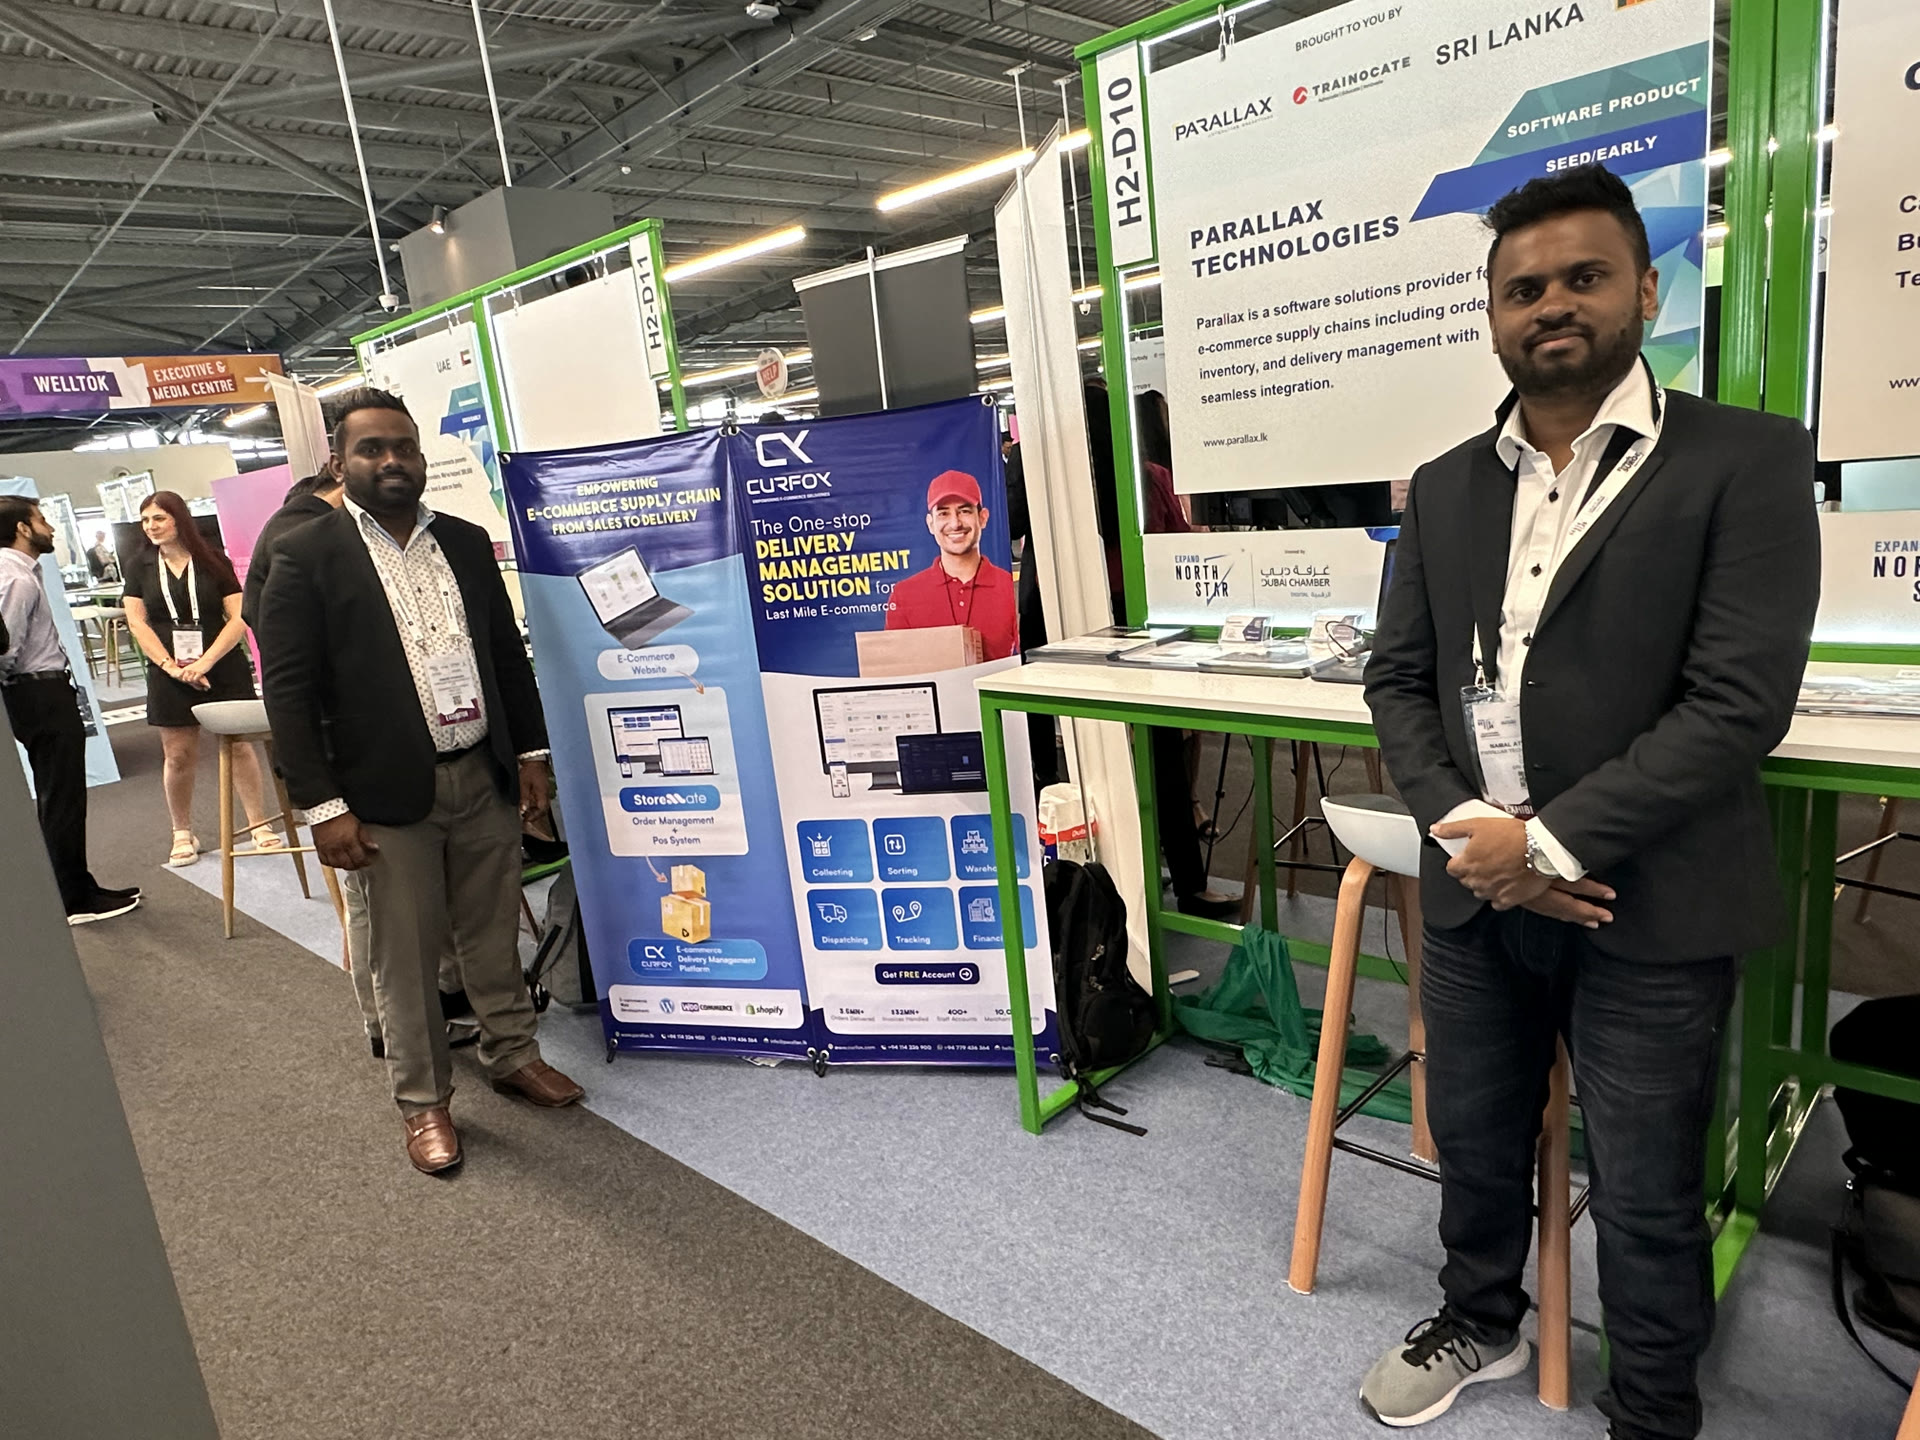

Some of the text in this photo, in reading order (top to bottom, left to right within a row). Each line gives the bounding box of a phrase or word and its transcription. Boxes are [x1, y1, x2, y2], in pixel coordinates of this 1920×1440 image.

[1295, 6, 1403, 51] BROUGHT TO YOU BY
[1435, 2, 1584, 66] SRI LANKA
[1312, 56, 1411, 97] TRAINOCATE
[1507, 77, 1700, 138] SOFTWARE PRODUCT
[1175, 96, 1273, 141] PARALLAX
[1107, 77, 1142, 227] H2-D10
[1545, 135, 1658, 173] SEED/EARLY
[1190, 199, 1324, 250] PARALLAX
[1191, 215, 1400, 279] TECHNOLOGIES
[636, 256, 662, 350] H2-D11
[1196, 265, 1488, 330] Parallax is a software solutions provider fo
[1197, 297, 1487, 355] e-commerce supply chains including orde
[1199, 327, 1480, 380] inventory, and delivery management with
[153, 361, 227, 383] EXECUTIVE &
[436, 358, 452, 374] UAE
[33, 374, 110, 393] WELLTOK
[152, 378, 235, 400] MEDIA CENTRE
[1200, 378, 1335, 405] seamless integration.
[1203, 432, 1268, 448] www.parallax.lk
[576, 477, 659, 497] EMPOWERING
[746, 472, 832, 495] CURFOX
[527, 487, 721, 521] E-COMMERCE SUPPLY CHAIN
[552, 509, 698, 536] FROM SALES TO DELIVERY
[751, 513, 871, 535] The One-stop
[755, 532, 855, 559] DELIVERY
[1875, 540, 1920, 552] EXPAN
[759, 550, 910, 581] MANAGEMENT
[1175, 554, 1200, 564] EXPAND
[1175, 565, 1219, 580] NORTH
[1261, 578, 1331, 587] DUBAI CHAMBER
[763, 577, 896, 603] SOLUTION for
[1195, 581, 1229, 598] STAR
[766, 602, 897, 620] Last Mile E-commerce
[617, 653, 676, 664] E-Commerce
[632, 666, 667, 675] Website
[632, 816, 714, 827] Order Management
[652, 835, 701, 847] Pos System
[812, 868, 853, 877] Collecting
[888, 867, 918, 876] Sorting
[822, 935, 868, 945] Dispatching
[896, 936, 931, 945] Tracking
[973, 934, 1003, 943] Financi
[676, 945, 722, 954] E-commerce
[677, 955, 707, 964] Delivery
[679, 964, 710, 973] Platform
[882, 970, 955, 979] Get FREE Account
[756, 1005, 784, 1015] shopify
